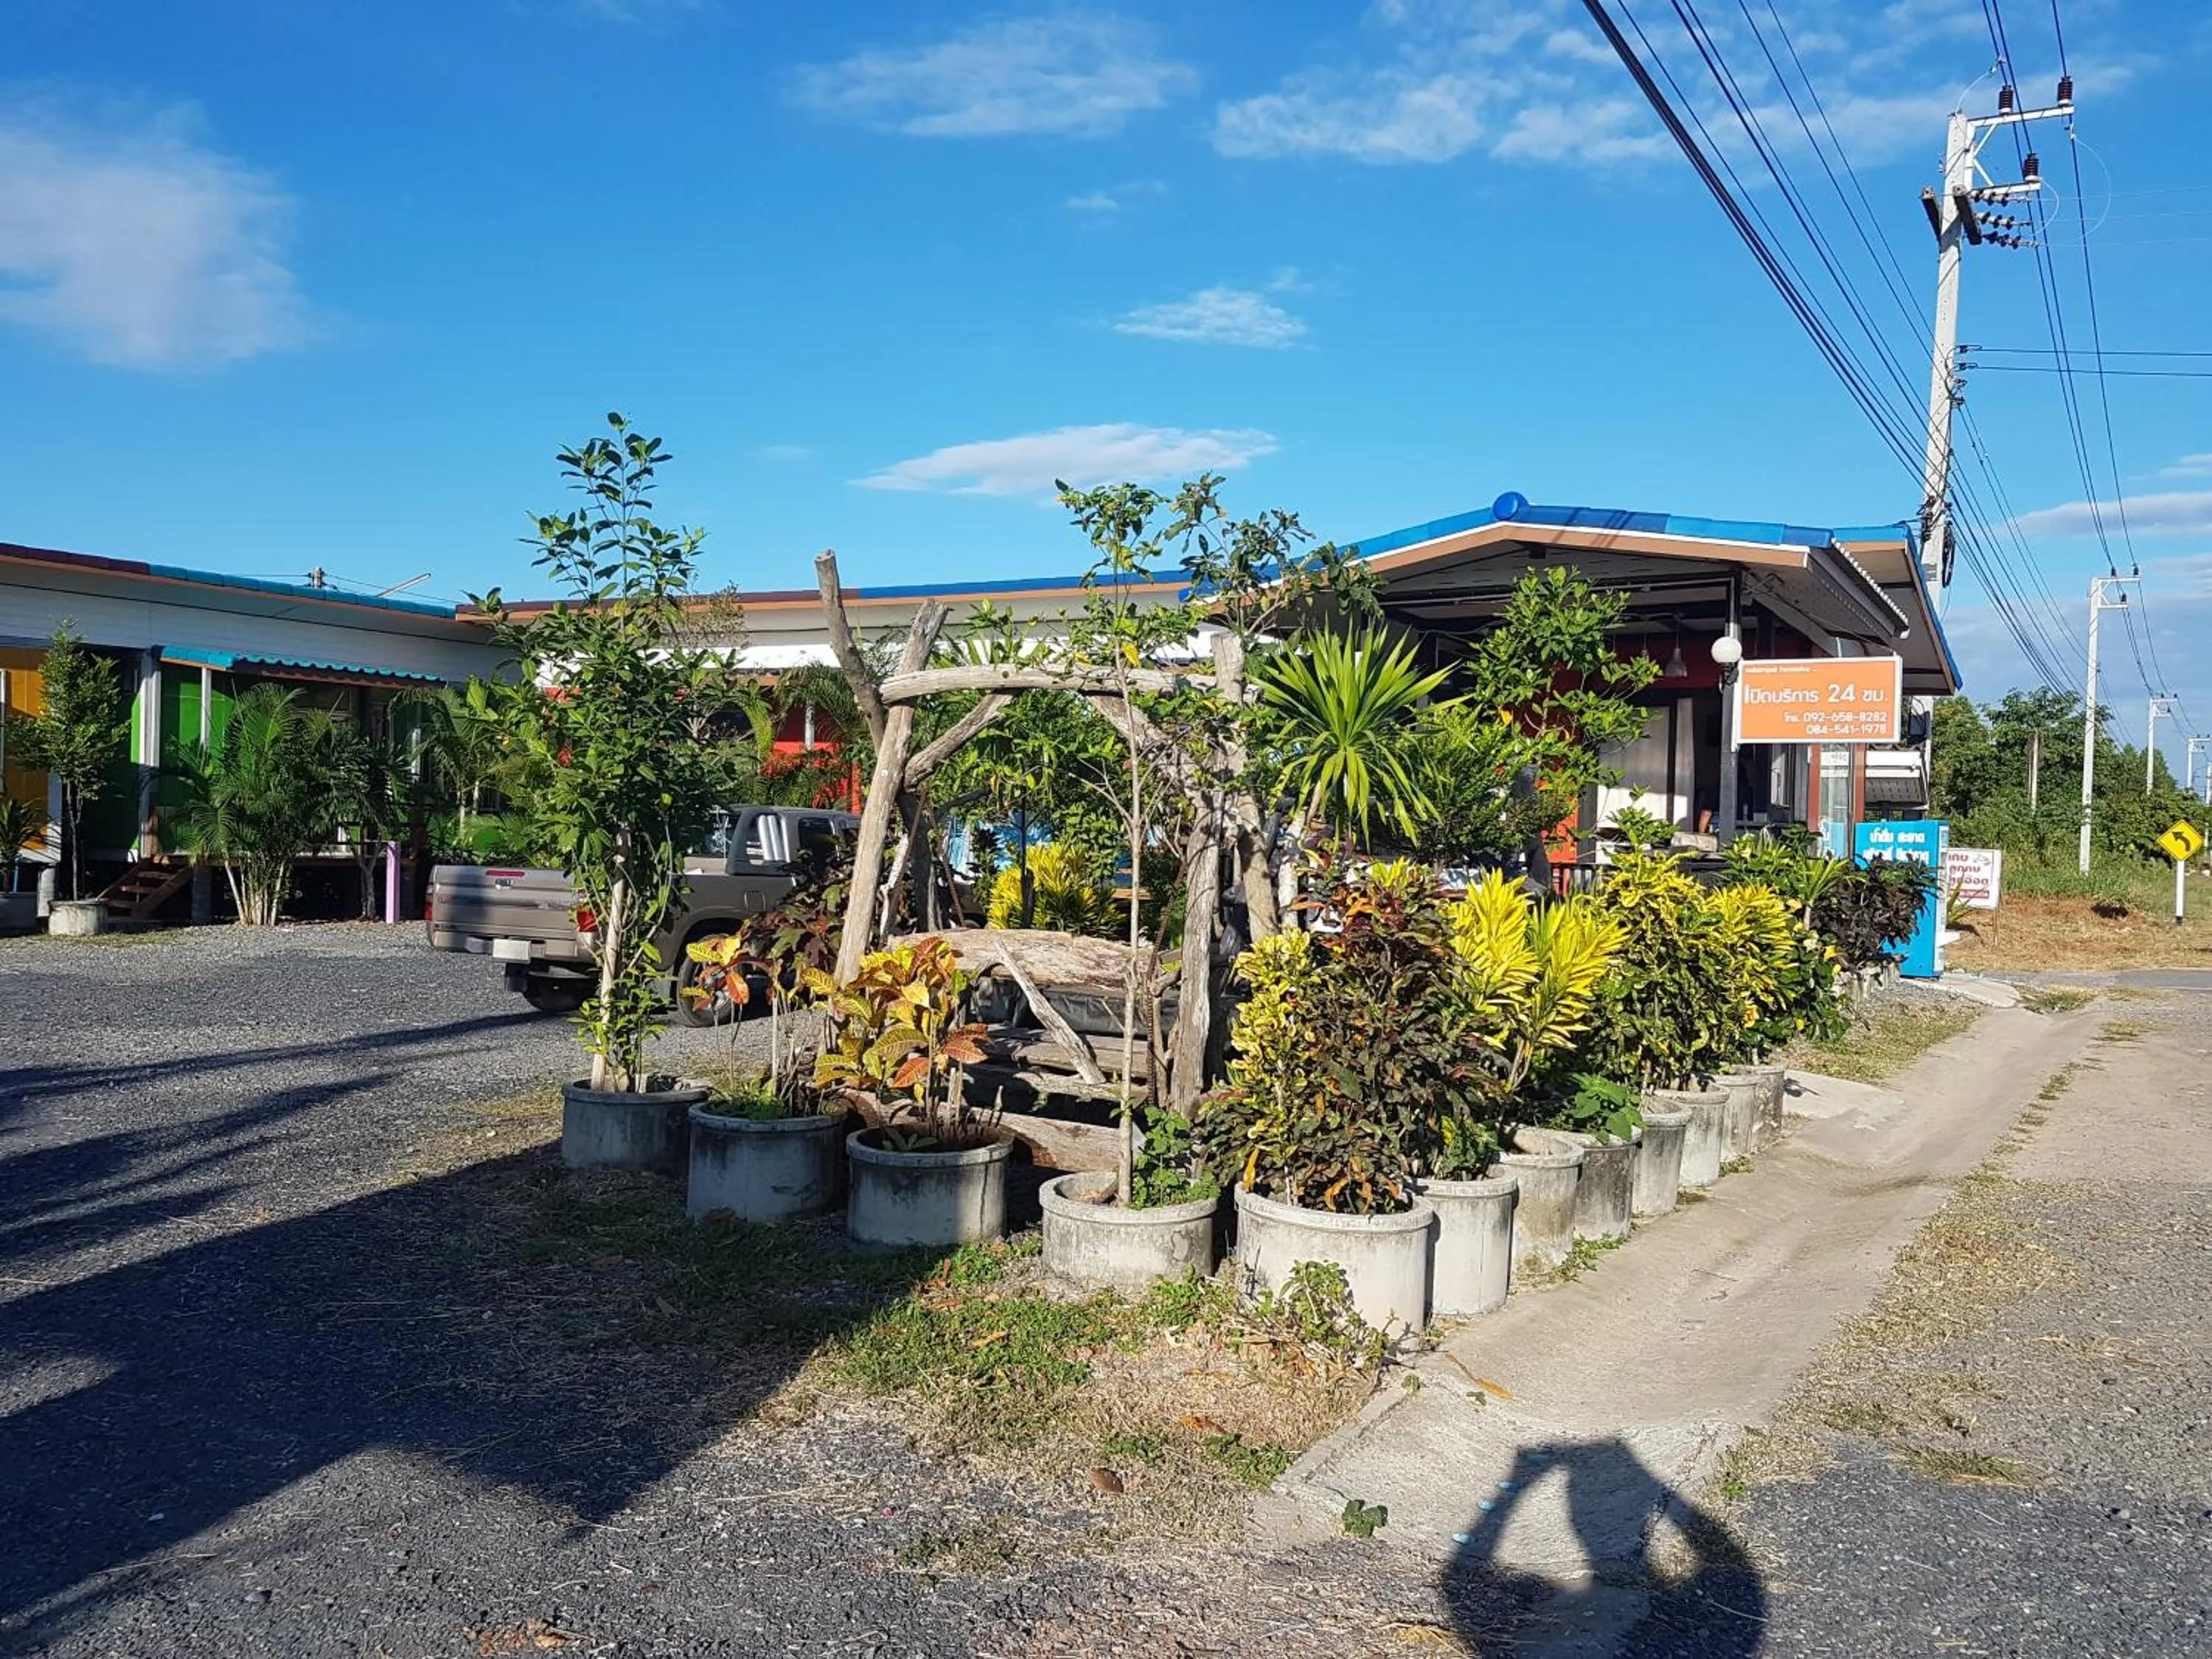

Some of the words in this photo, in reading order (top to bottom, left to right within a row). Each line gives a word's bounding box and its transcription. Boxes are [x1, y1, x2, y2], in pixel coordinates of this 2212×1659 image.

[1745, 684, 1819, 704] เปิดบริการ
[1828, 684, 1856, 703] 24
[1863, 689, 1888, 702] ชม.
